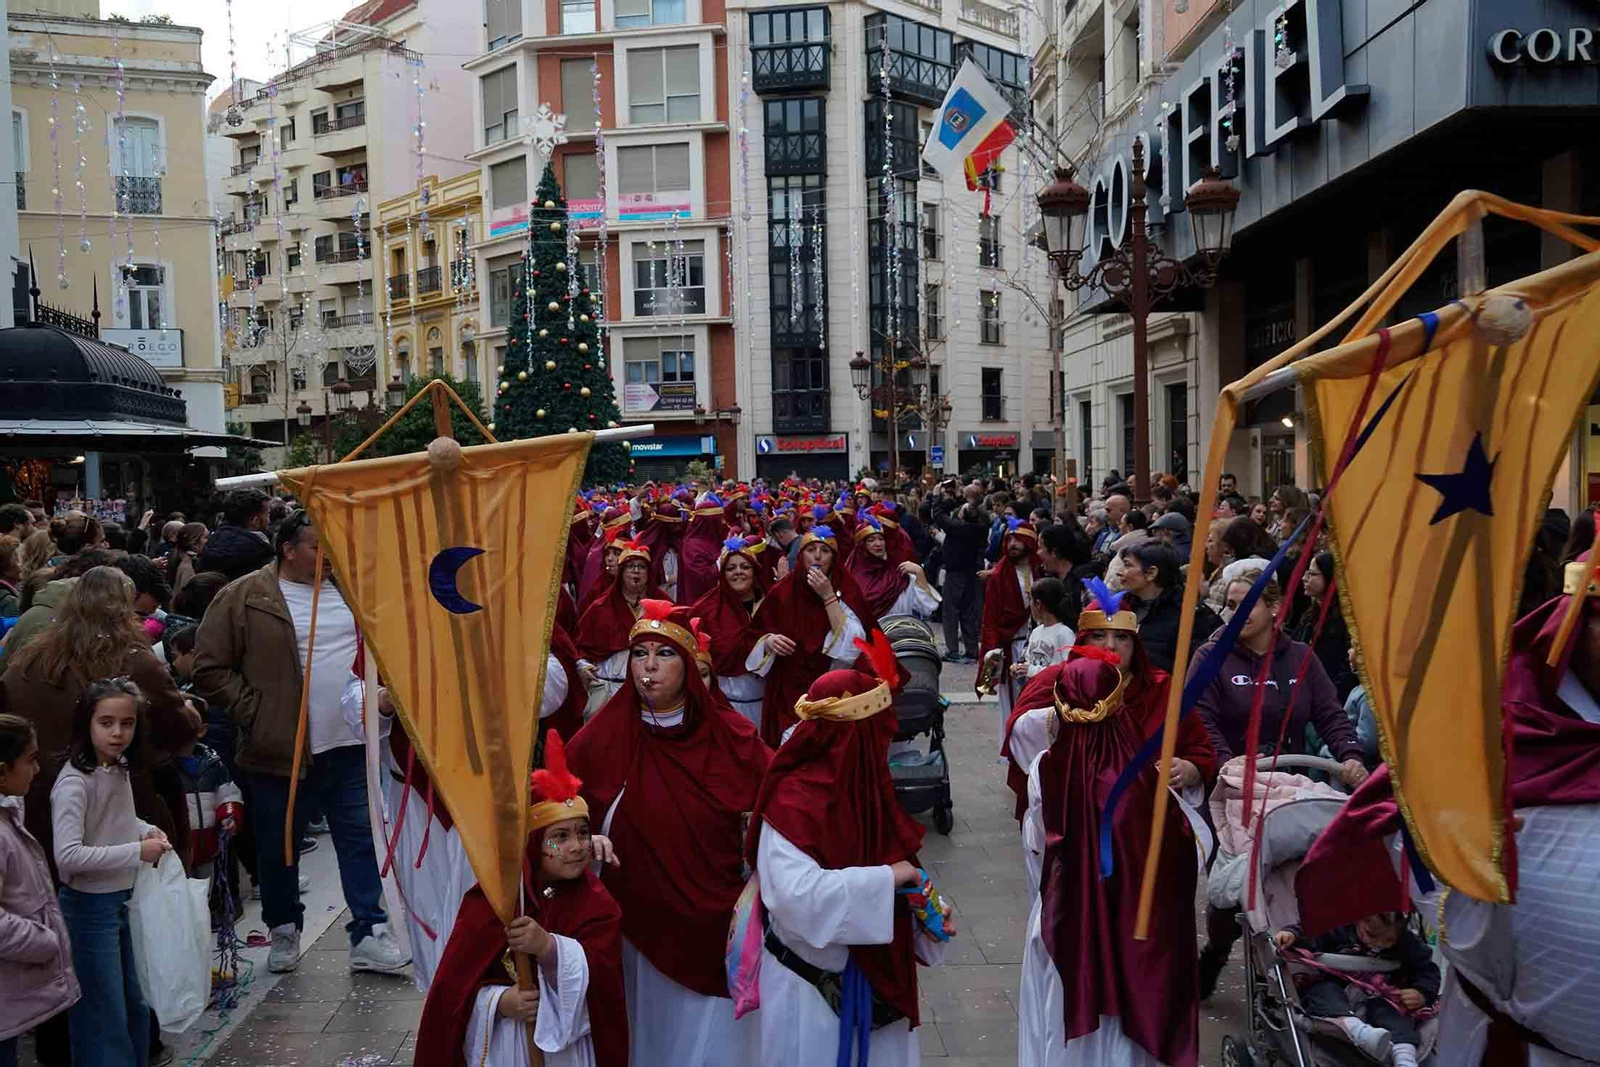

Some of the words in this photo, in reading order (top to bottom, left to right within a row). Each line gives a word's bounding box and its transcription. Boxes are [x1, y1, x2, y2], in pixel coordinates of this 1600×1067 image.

[1492, 28, 1600, 64] COR
[632, 443, 663, 451] movistar
[777, 437, 844, 452] Soloptical
